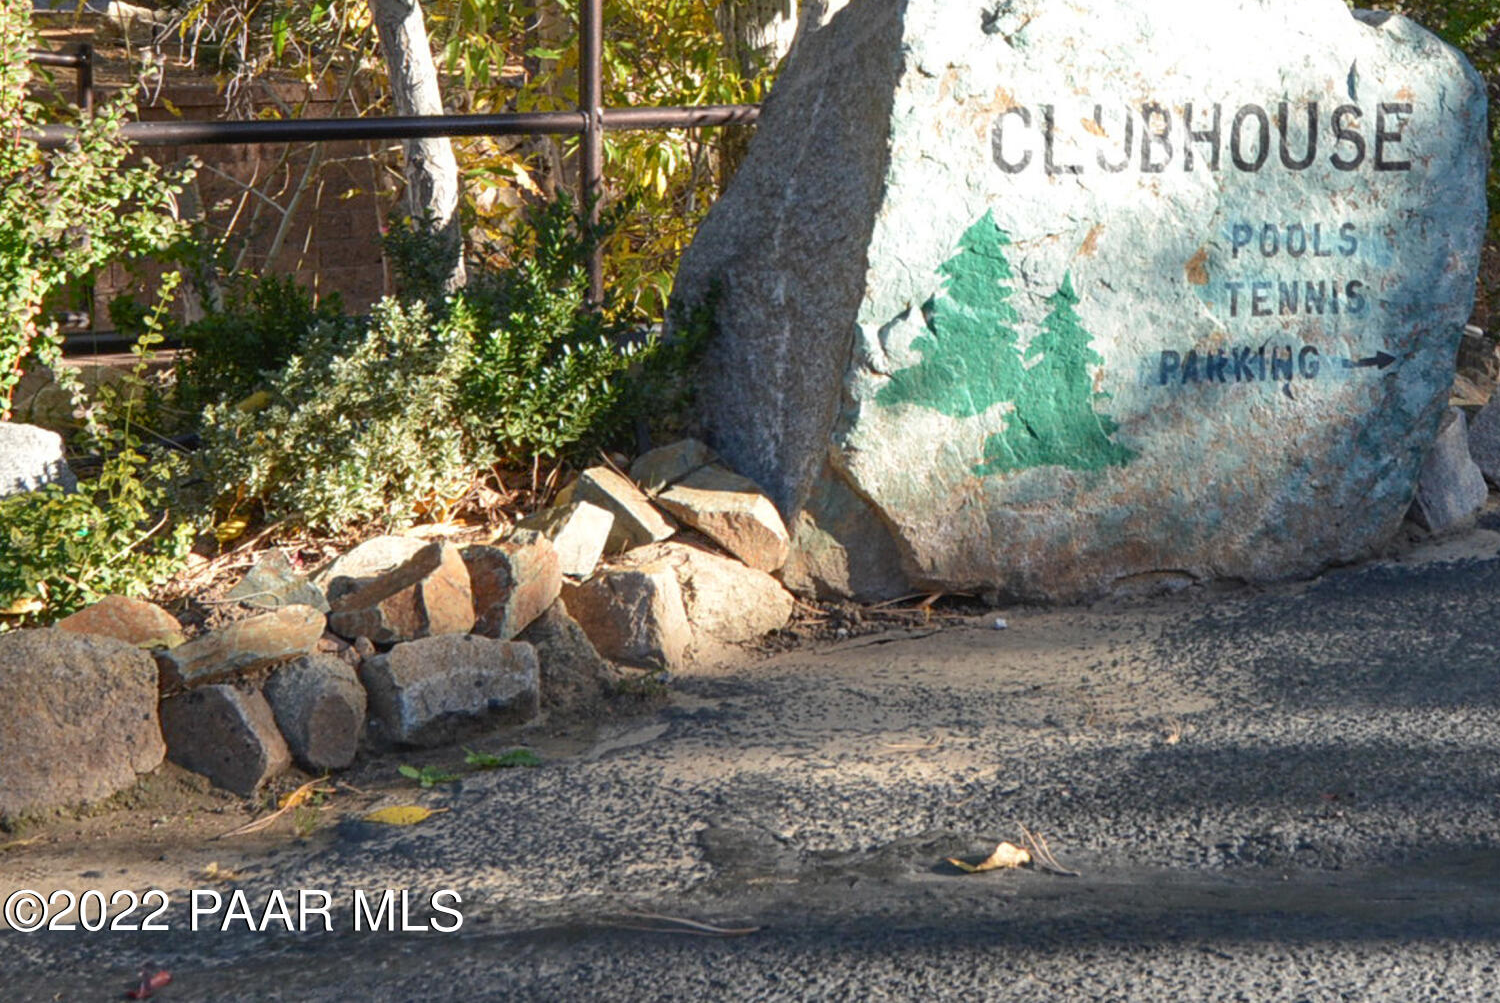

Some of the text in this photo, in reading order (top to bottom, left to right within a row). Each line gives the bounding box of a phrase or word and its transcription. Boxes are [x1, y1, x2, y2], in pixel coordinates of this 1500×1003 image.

[991, 102, 1413, 174] CLUBHOUSE
[1230, 222, 1359, 259] POOLS
[1224, 280, 1366, 317] TENNIS
[1159, 345, 1320, 384] PARKING
